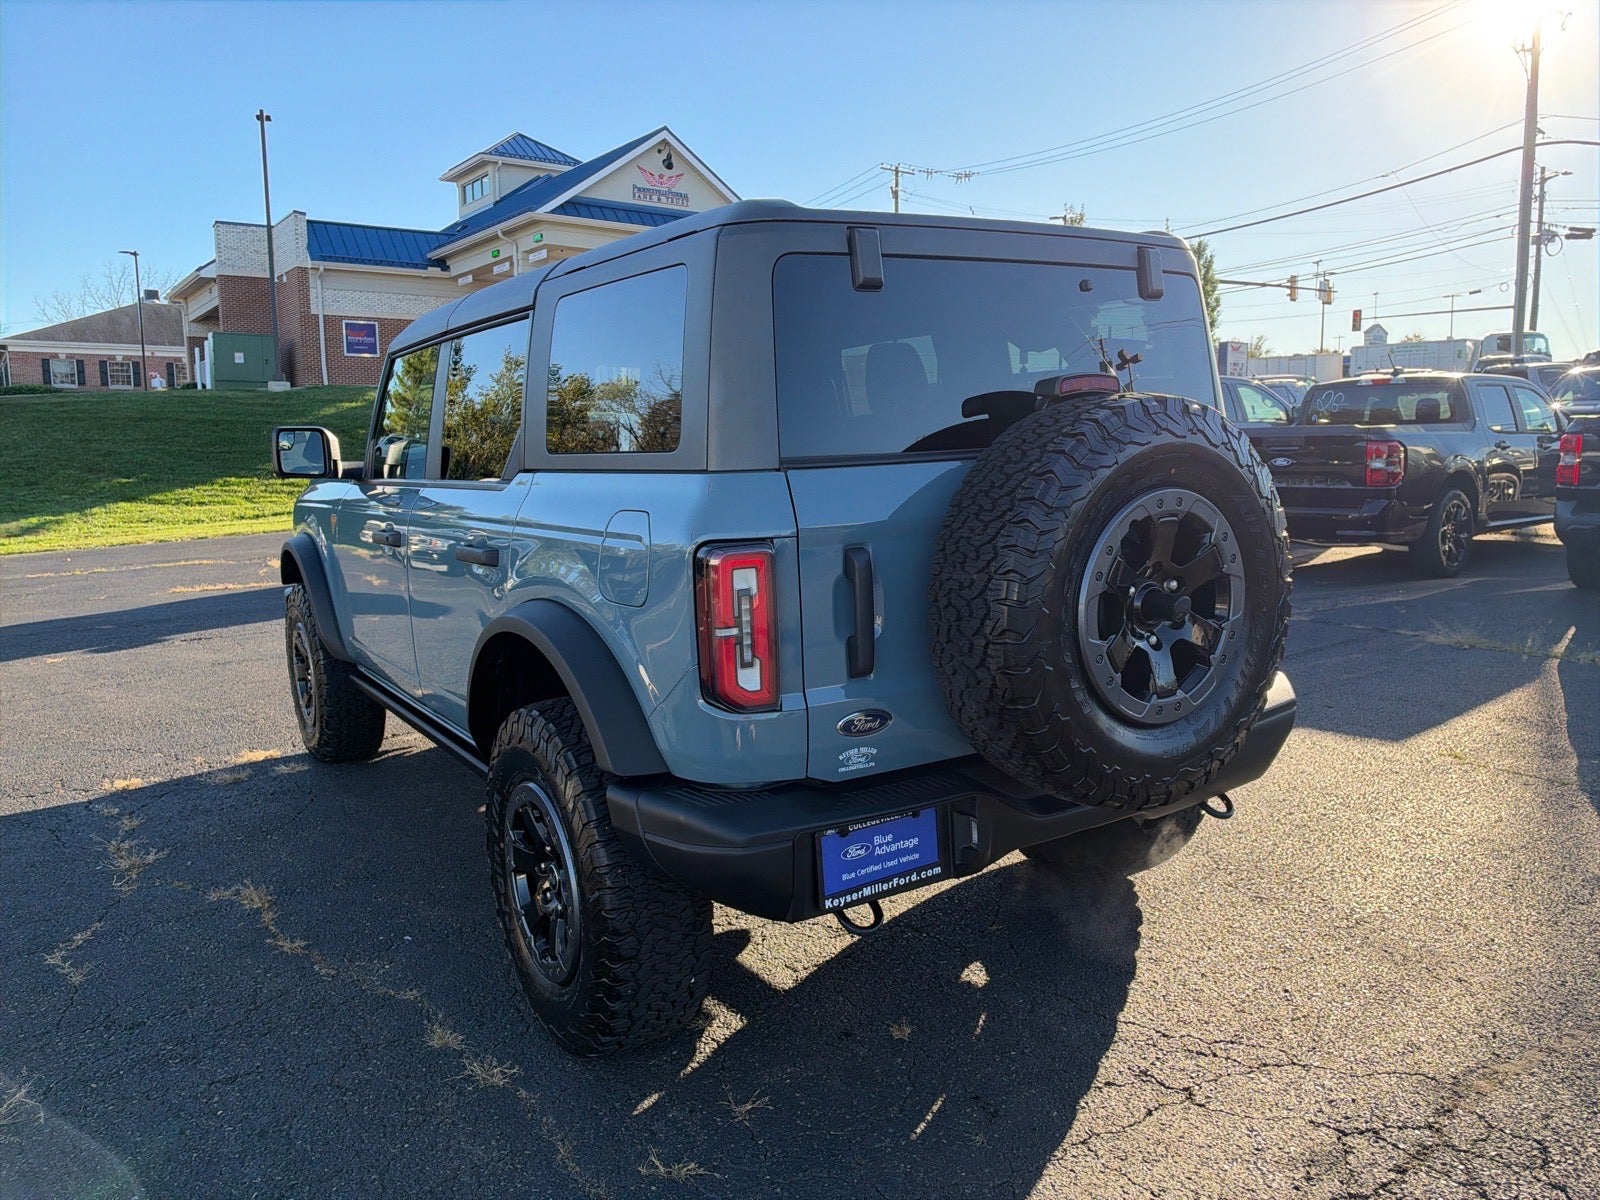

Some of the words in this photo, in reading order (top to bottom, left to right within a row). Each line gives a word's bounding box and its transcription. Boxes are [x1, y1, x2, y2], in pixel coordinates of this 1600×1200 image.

[851, 716, 881, 732] Ford
[859, 746, 878, 755] MILLER
[848, 754, 868, 764] Ford
[873, 833, 893, 846] Blue
[846, 845, 866, 858] Ford
[874, 837, 919, 857] Advantage
[841, 871, 856, 881] Blue
[856, 863, 882, 876] Certified
[882, 858, 898, 868] Used
[898, 852, 920, 864] Vehicle
[824, 865, 942, 909] KeyserMillerFord.com
